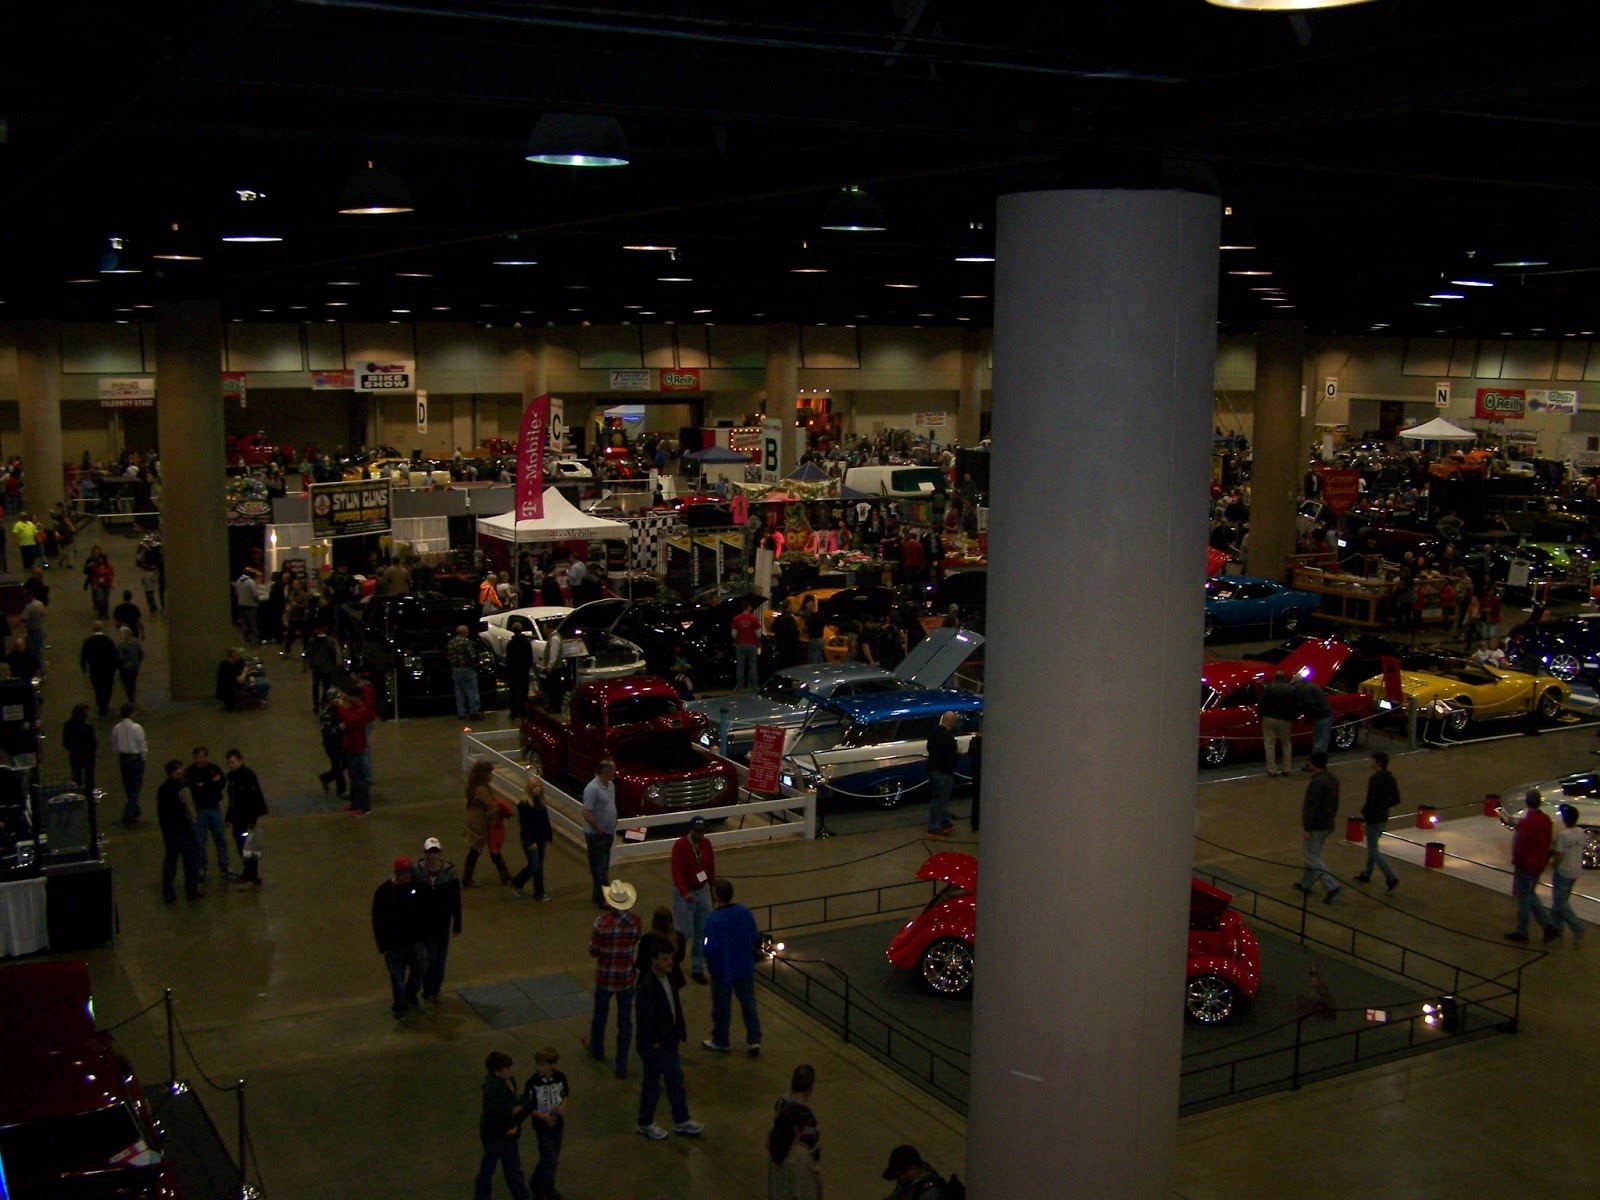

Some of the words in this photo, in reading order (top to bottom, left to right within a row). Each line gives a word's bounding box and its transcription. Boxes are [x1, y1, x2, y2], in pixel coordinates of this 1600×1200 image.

[1438, 389, 1447, 402] N
[419, 402, 425, 423] D
[552, 413, 561, 441] C
[765, 438, 777, 471] B
[332, 492, 360, 511] STUN
[362, 489, 388, 507] GUNS
